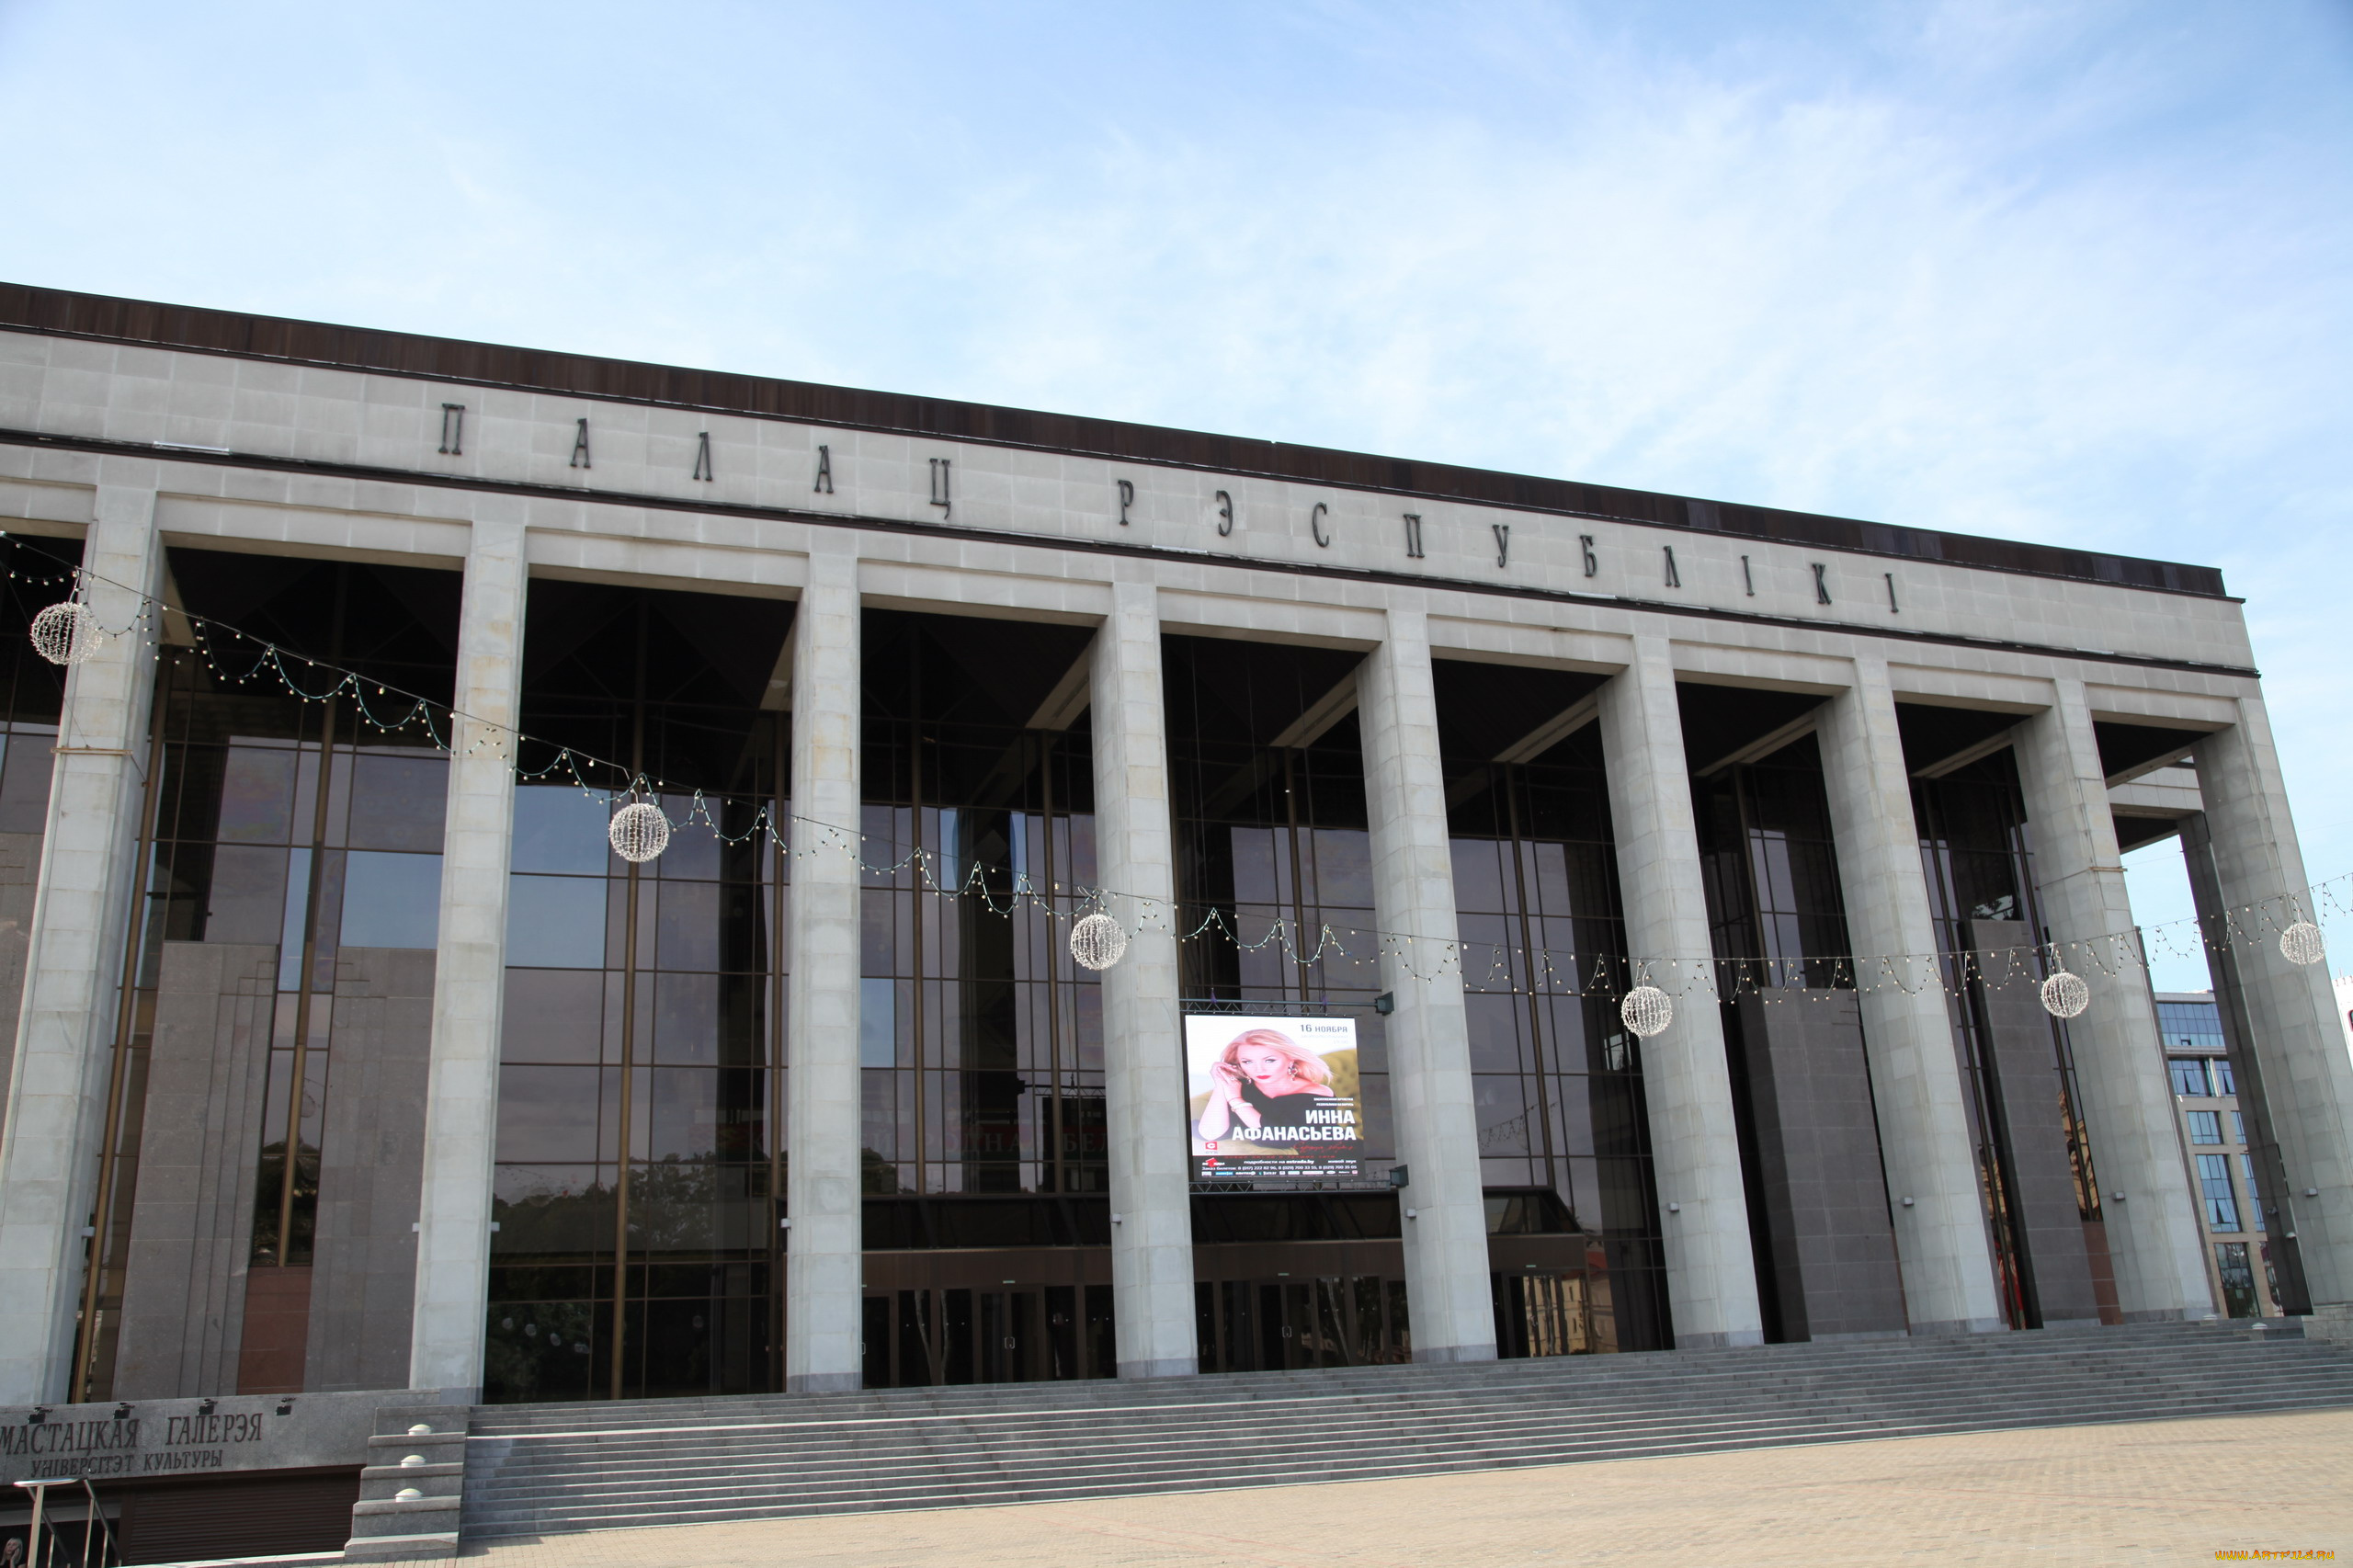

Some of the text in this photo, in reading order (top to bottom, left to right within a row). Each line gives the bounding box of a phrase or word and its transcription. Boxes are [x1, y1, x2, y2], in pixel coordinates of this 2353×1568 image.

[438, 403, 1899, 614] ПАЛАЦ РЭСПУБЛІКІ
[1300, 1024, 1313, 1032] 16
[1305, 1109, 1356, 1124] ИННА
[1232, 1126, 1357, 1141] АФАНАСЬЕВА
[0, 1413, 263, 1456] МАСТАЦКАЯ ГАЛЕРЭЯ
[31, 1449, 222, 1478] УНІВЕРСІТЭТ КУЛЬТУРЫ
